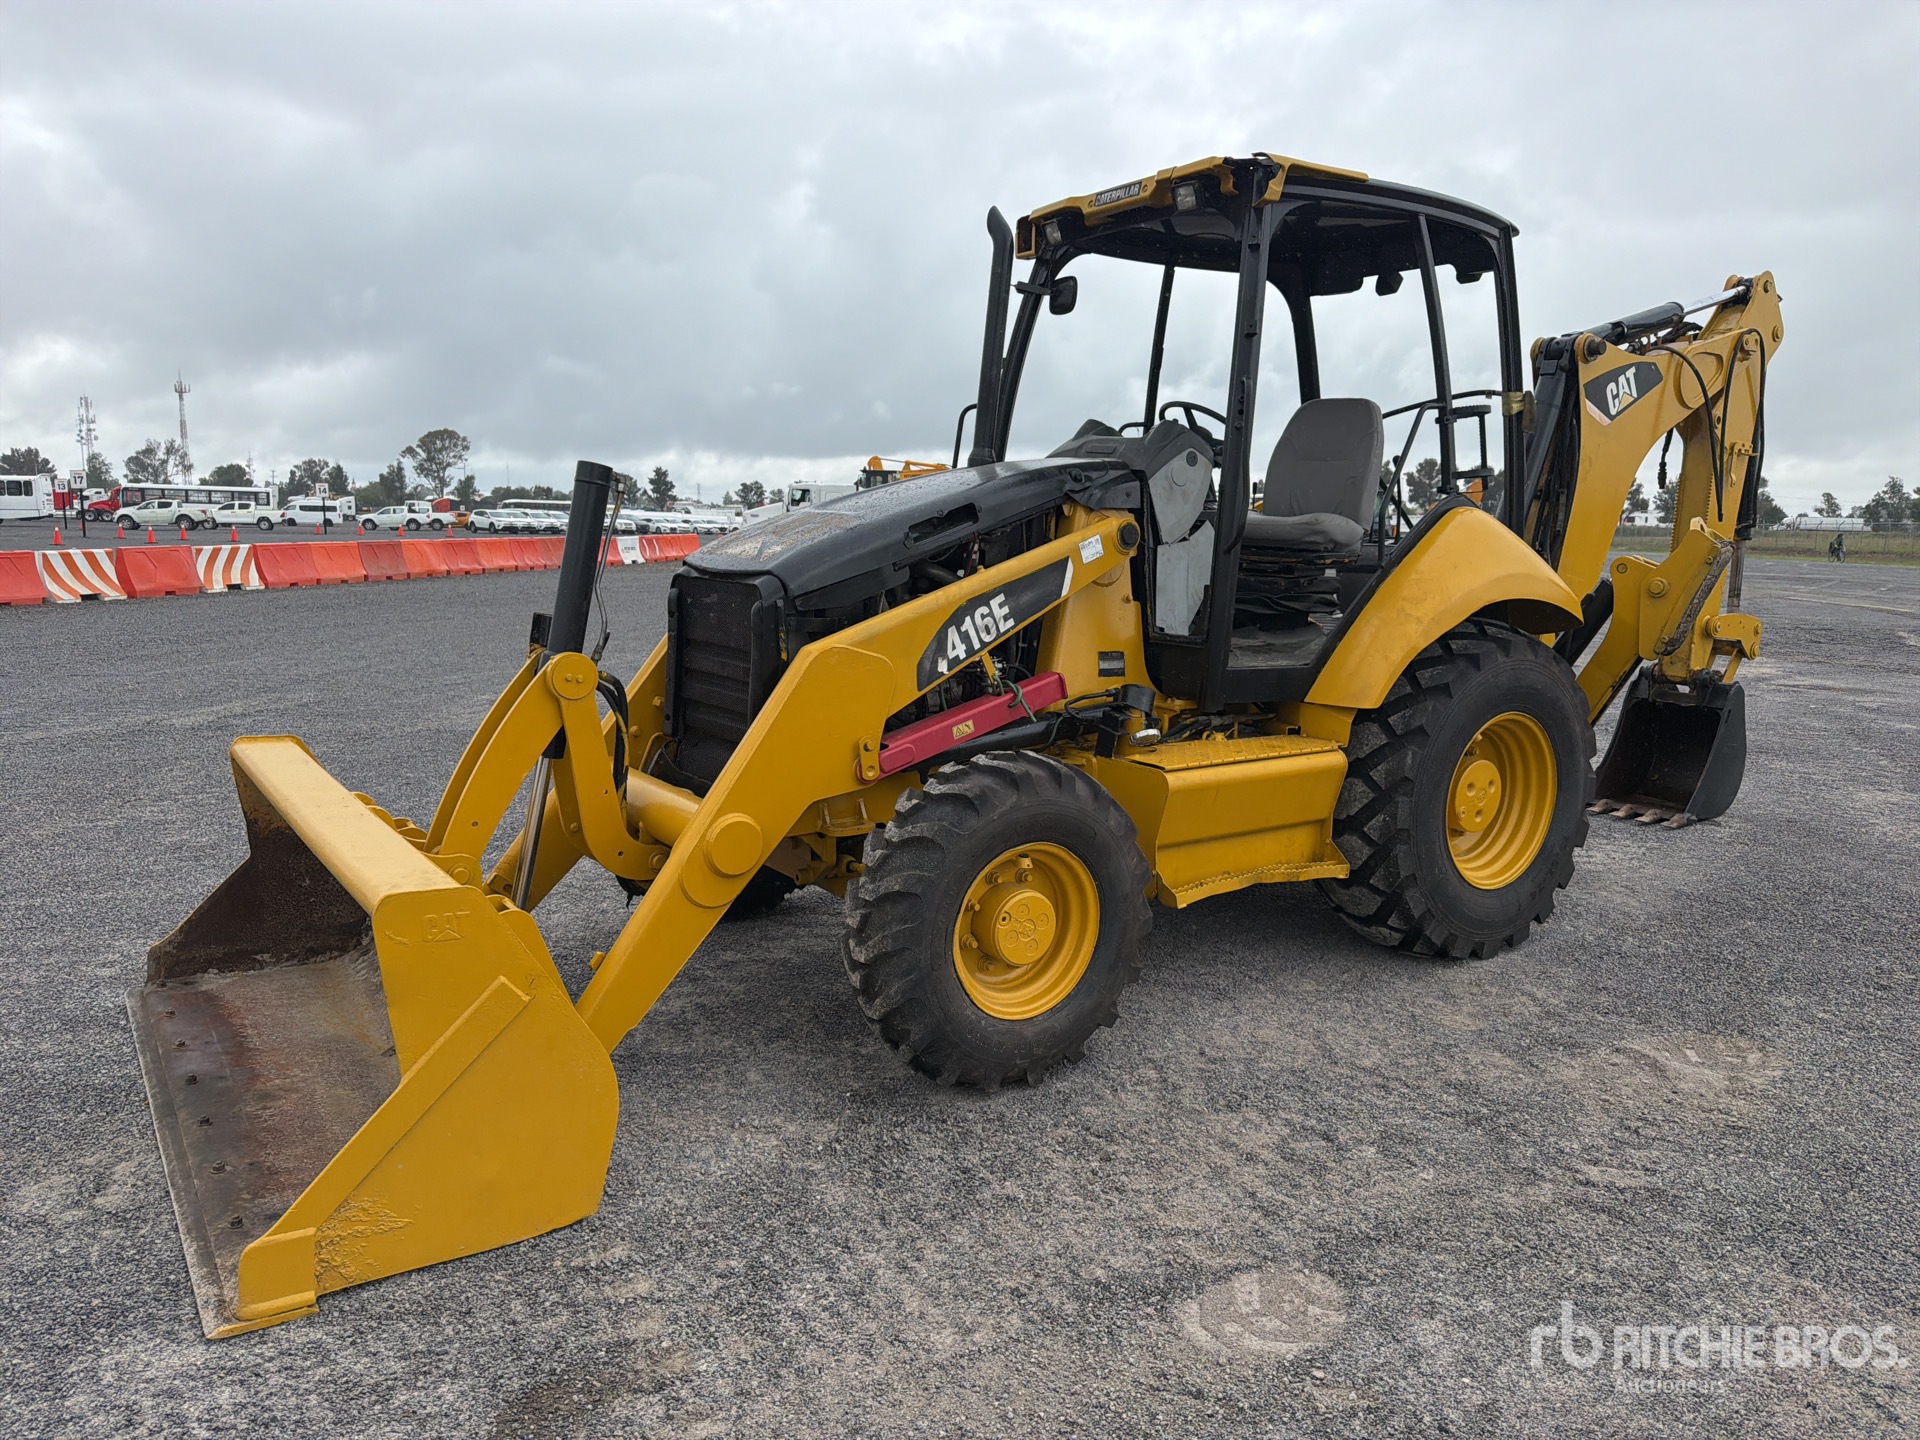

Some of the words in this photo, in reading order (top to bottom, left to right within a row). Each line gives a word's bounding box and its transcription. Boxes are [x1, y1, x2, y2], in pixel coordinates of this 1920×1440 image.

[1095, 184, 1140, 206] CATERPILLAR
[1606, 365, 1638, 416] CAT
[57, 483, 66, 491] 13
[73, 475, 84, 485] 17
[317, 487, 328, 495] 14
[947, 592, 1016, 661] 416E
[422, 910, 471, 943] CAT
